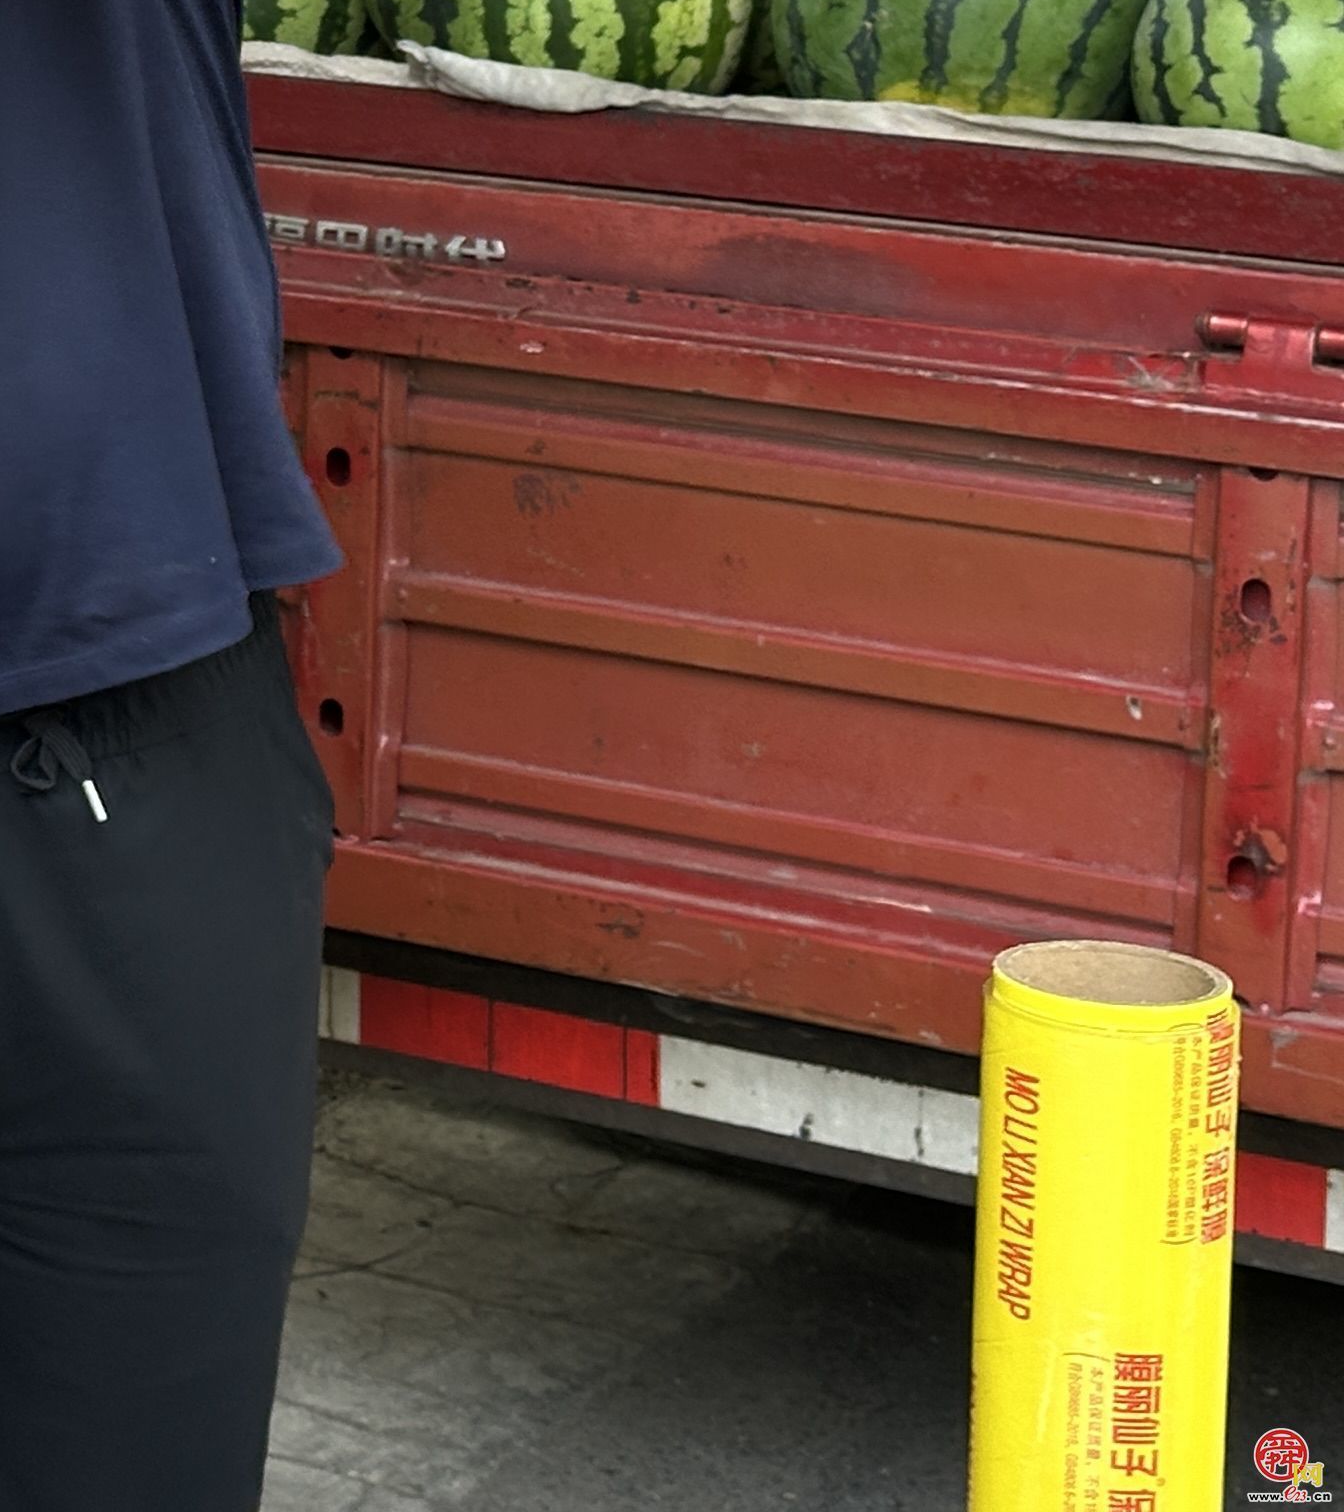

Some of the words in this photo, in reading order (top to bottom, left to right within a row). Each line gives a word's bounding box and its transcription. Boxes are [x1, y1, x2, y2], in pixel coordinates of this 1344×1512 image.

[1004, 1066, 1041, 1115] MO
[997, 1238, 1034, 1321] WRAP
[1110, 1352, 1164, 1477] 膜丽仙子
